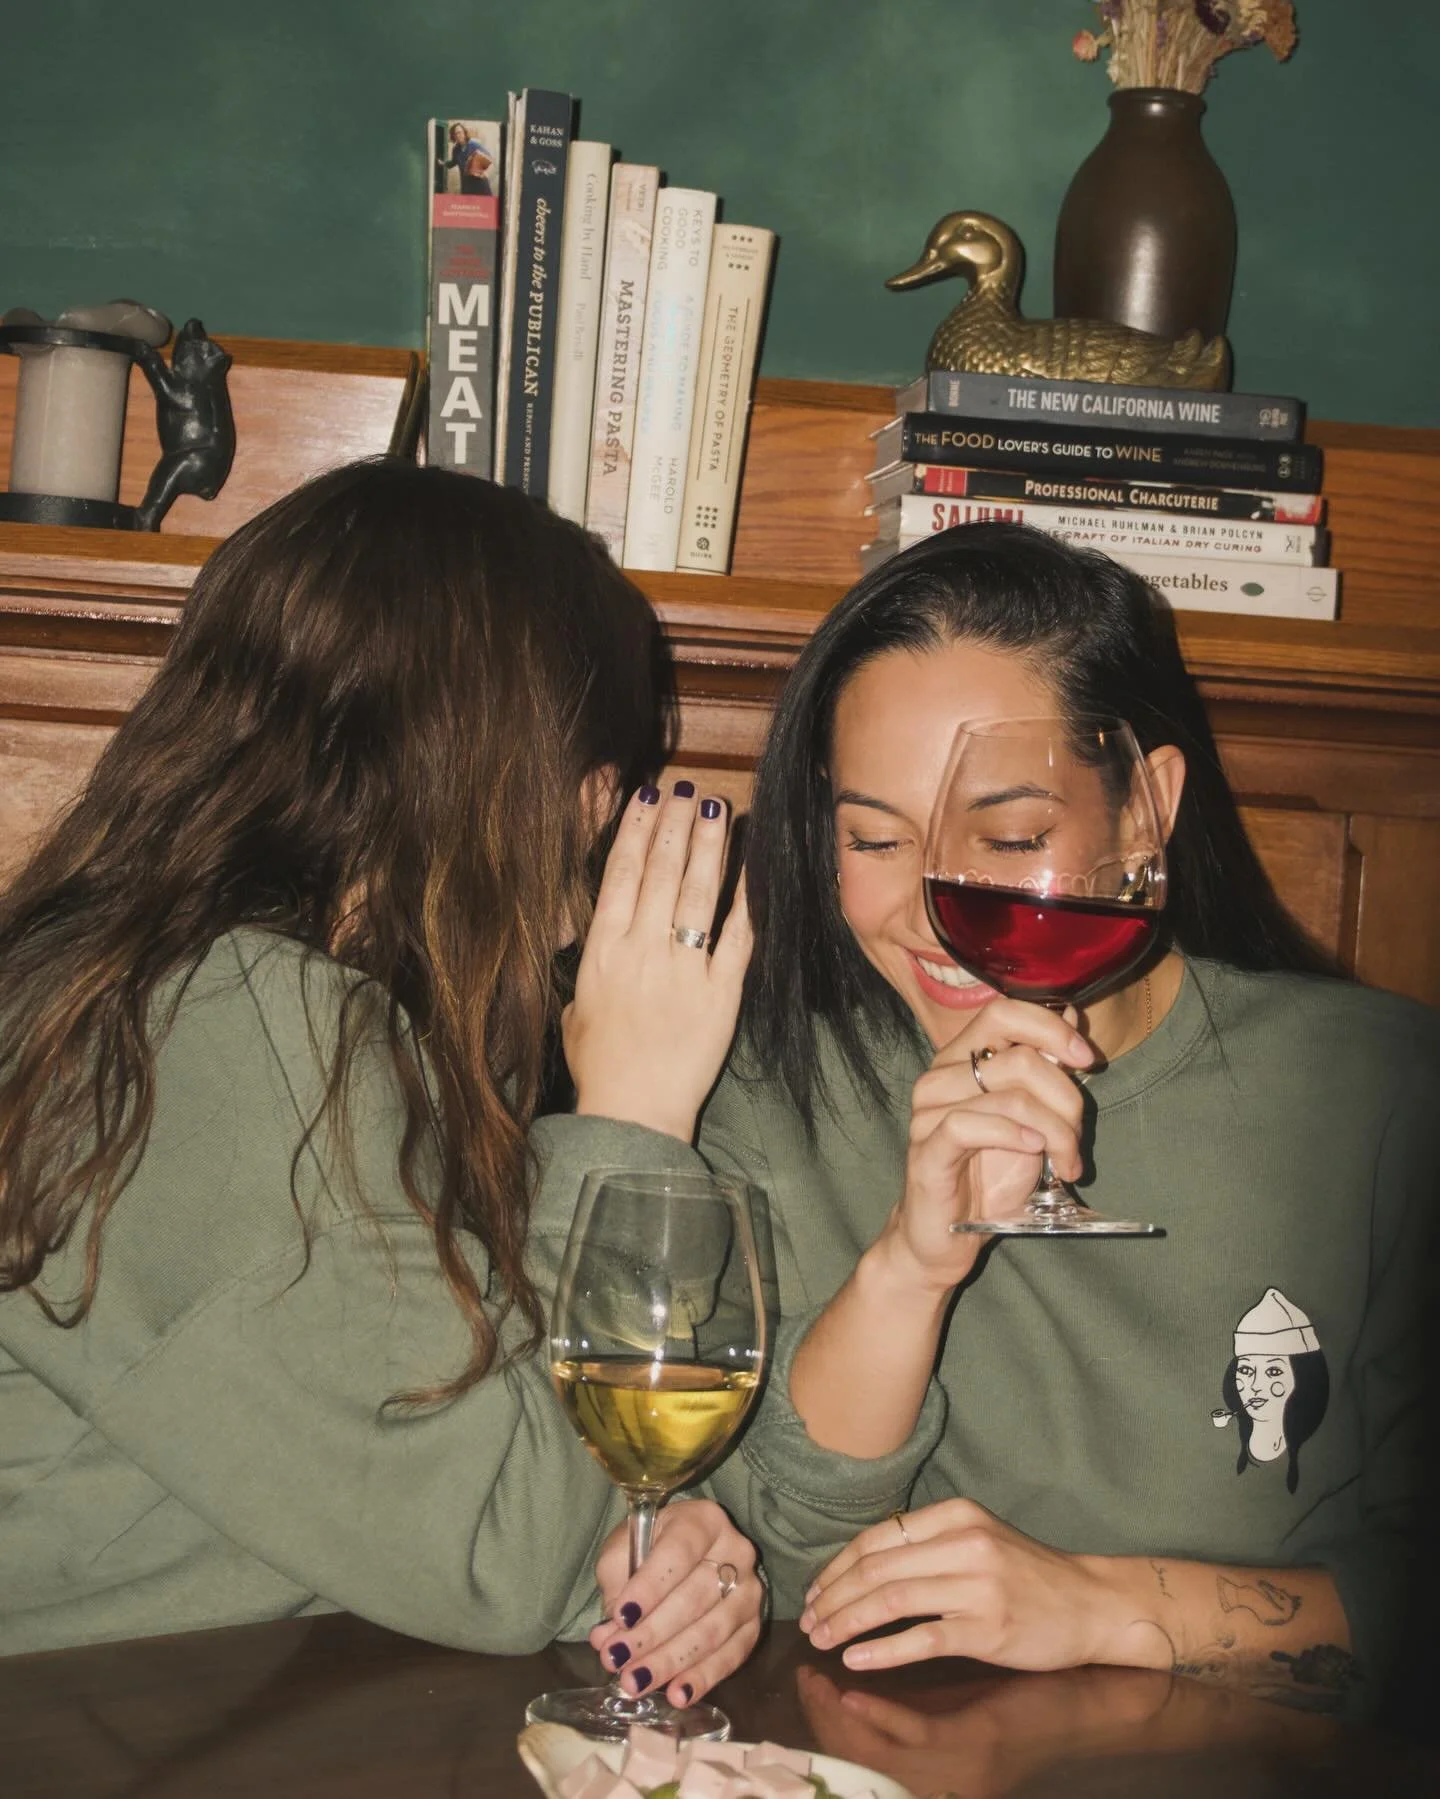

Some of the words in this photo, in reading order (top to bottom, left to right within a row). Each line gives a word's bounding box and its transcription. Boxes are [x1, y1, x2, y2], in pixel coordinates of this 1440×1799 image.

[534, 197, 551, 244] cheers
[657, 206, 673, 270] COOKING
[675, 208, 688, 249] GOOD
[691, 209, 703, 245] KEYS
[533, 249, 545, 261] to
[688, 249, 699, 267] TO
[532, 263, 547, 289] the
[725, 307, 738, 331] THE
[524, 291, 544, 396] PUBLICAN
[610, 280, 635, 404] MASTERING
[438, 282, 490, 465] MEAT
[719, 334, 735, 408] GEOMETRY
[714, 411, 726, 431] OF
[1008, 388, 1037, 409] THE
[1040, 391, 1078, 413] NEW
[1082, 394, 1174, 420] CALIFORNIA
[1178, 401, 1221, 424] WINE
[603, 411, 623, 476] PASTA
[709, 433, 722, 471] PASTA
[915, 432, 938, 446] THE
[941, 431, 995, 450] FOOD
[998, 439, 1049, 454] LOVER'S
[1052, 443, 1091, 457] GUIDE
[1095, 446, 1113, 459] TO
[1115, 443, 1162, 463] WINE
[664, 457, 678, 514] HAROLD
[1058, 515, 1105, 528] MICHAEL
[1112, 519, 1164, 533] RUHLMAN
[1170, 524, 1177, 534] &
[1183, 526, 1216, 537] BRIAN
[1221, 529, 1263, 540] POLCYN
[1063, 531, 1105, 541] CRAFT
[1110, 534, 1127, 543] OF
[1132, 536, 1180, 547] ITALIAN
[1186, 540, 1209, 549] DRY
[1214, 542, 1262, 554] CURING
